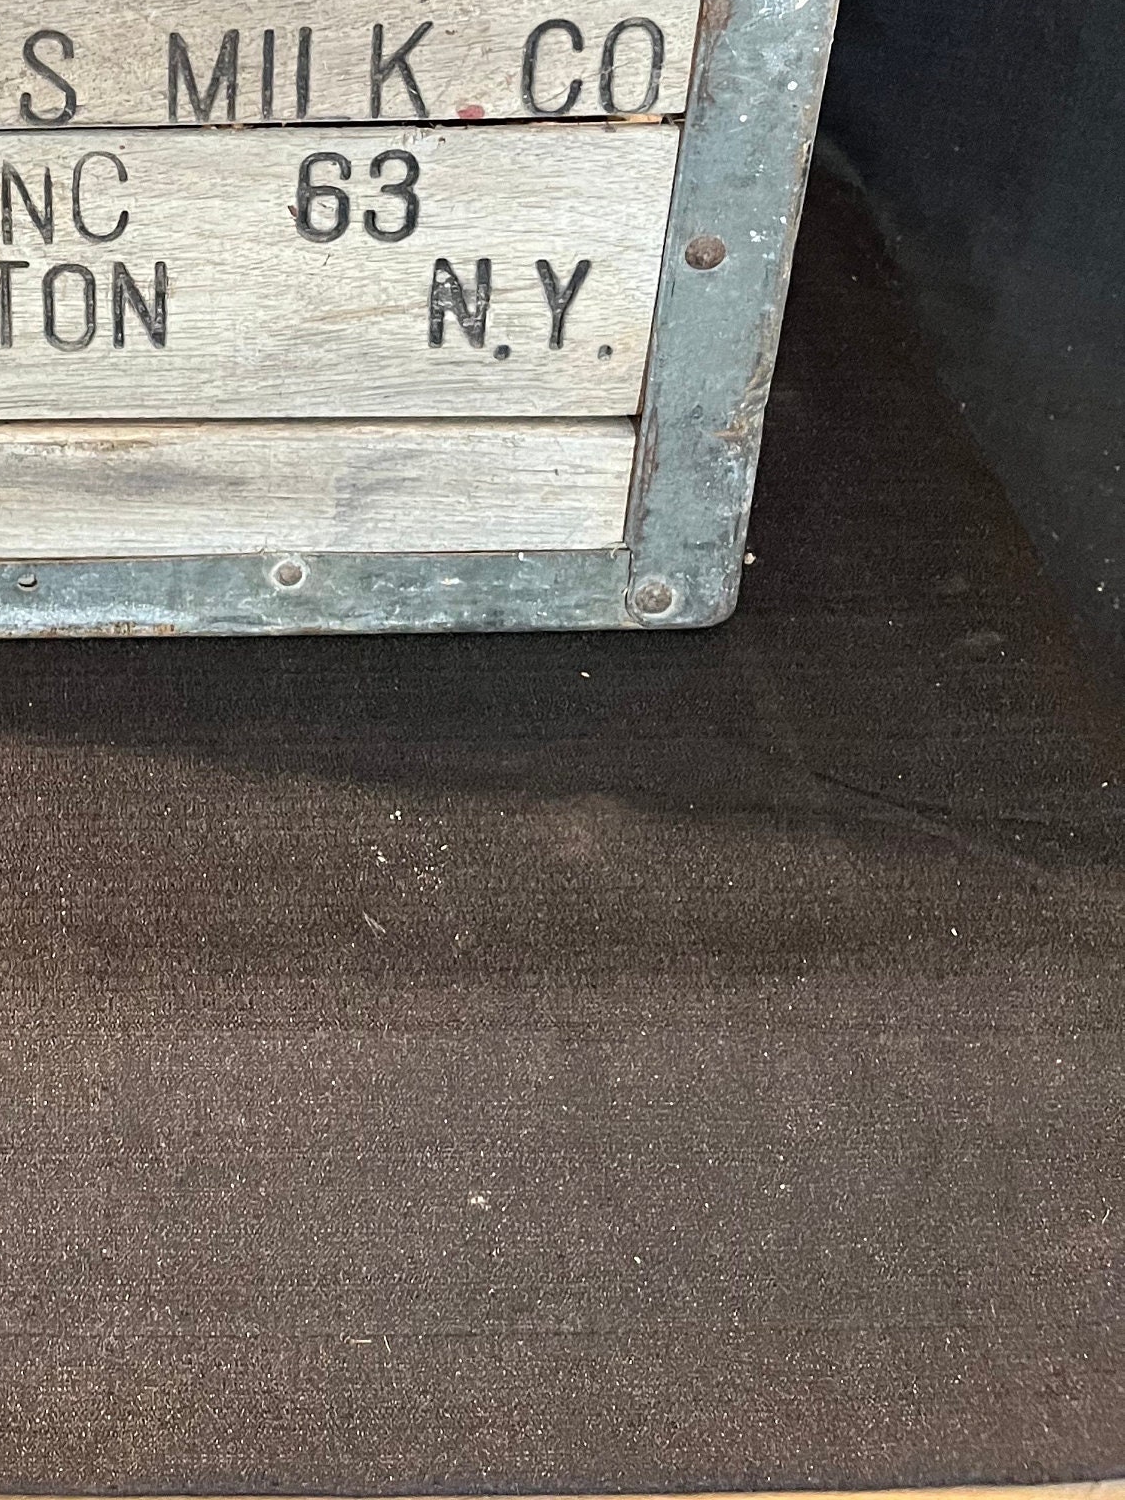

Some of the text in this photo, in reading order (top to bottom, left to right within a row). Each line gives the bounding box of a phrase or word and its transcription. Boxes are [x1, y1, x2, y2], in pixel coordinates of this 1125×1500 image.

[167, 20, 434, 122] MILK
[521, 16, 665, 116] CO
[295, 148, 421, 243] 63
